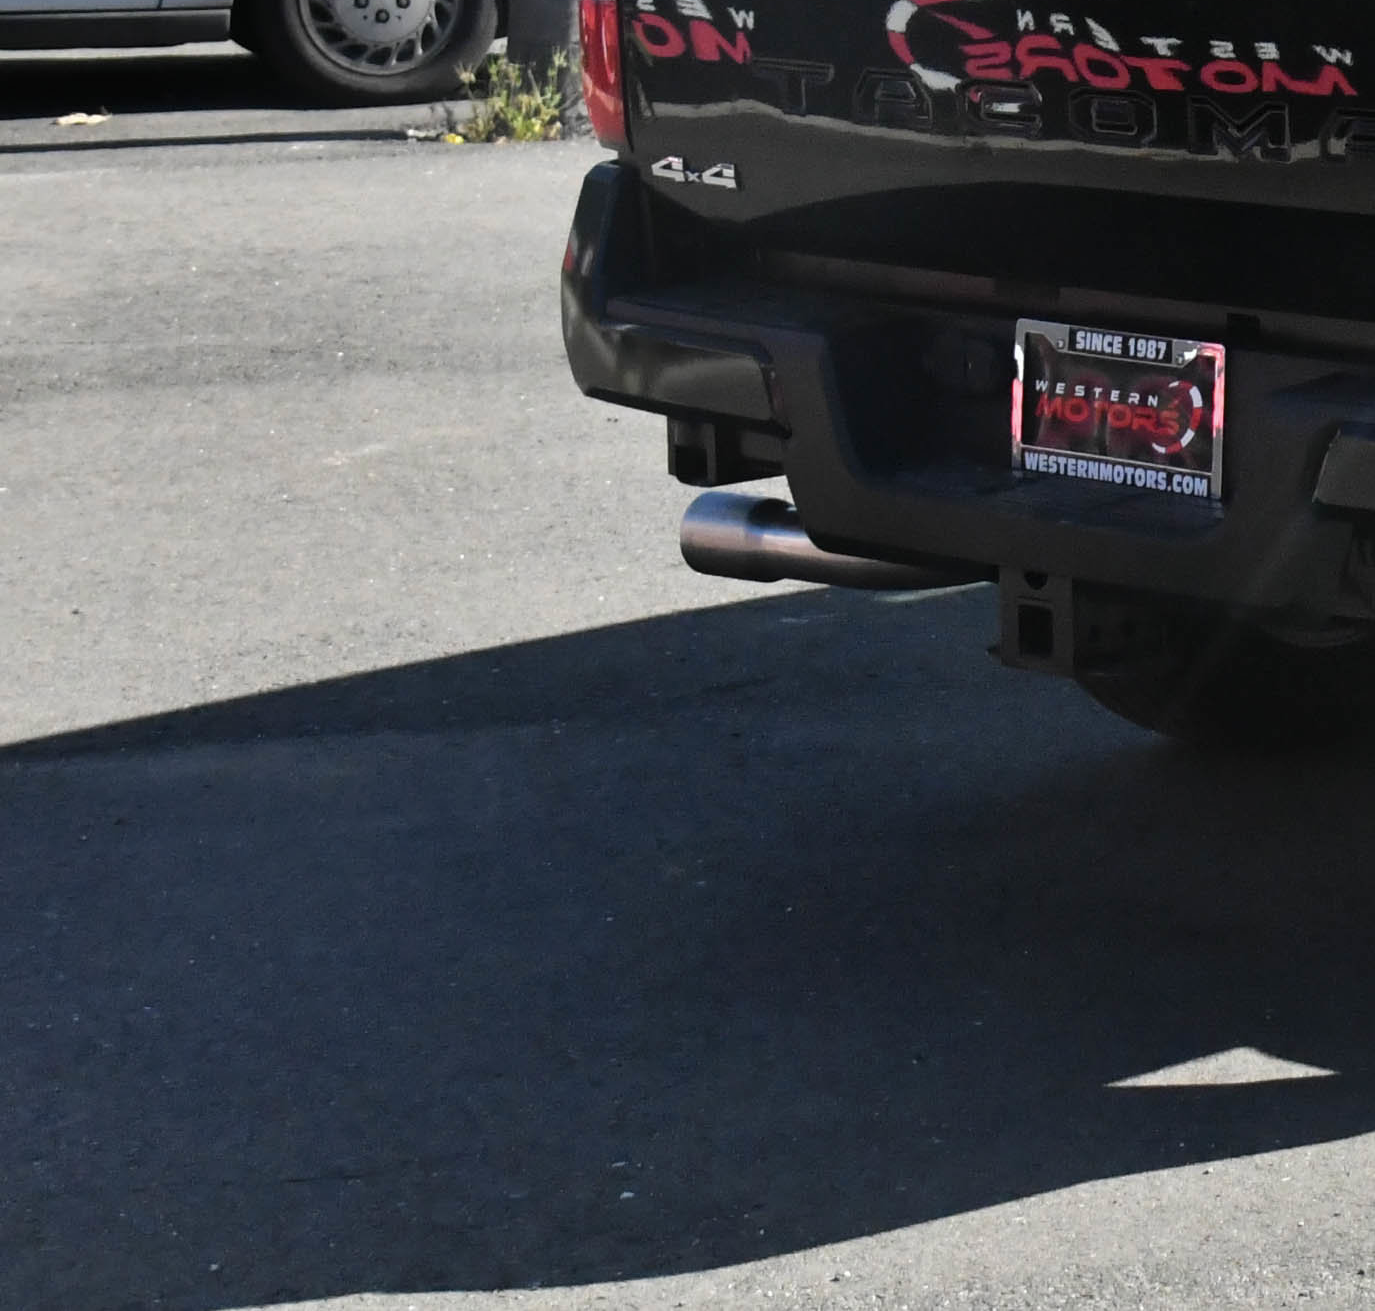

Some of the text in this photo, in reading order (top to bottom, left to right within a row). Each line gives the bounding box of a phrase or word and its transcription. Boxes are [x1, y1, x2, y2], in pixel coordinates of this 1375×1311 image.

[651, 155, 738, 189] 4x4
[1075, 330, 1167, 360] SINCE 1987
[1035, 379, 1159, 407] WESTERN
[1036, 393, 1180, 436] MOTORS
[1024, 452, 1209, 497] WESTERNMOTORS.COM
